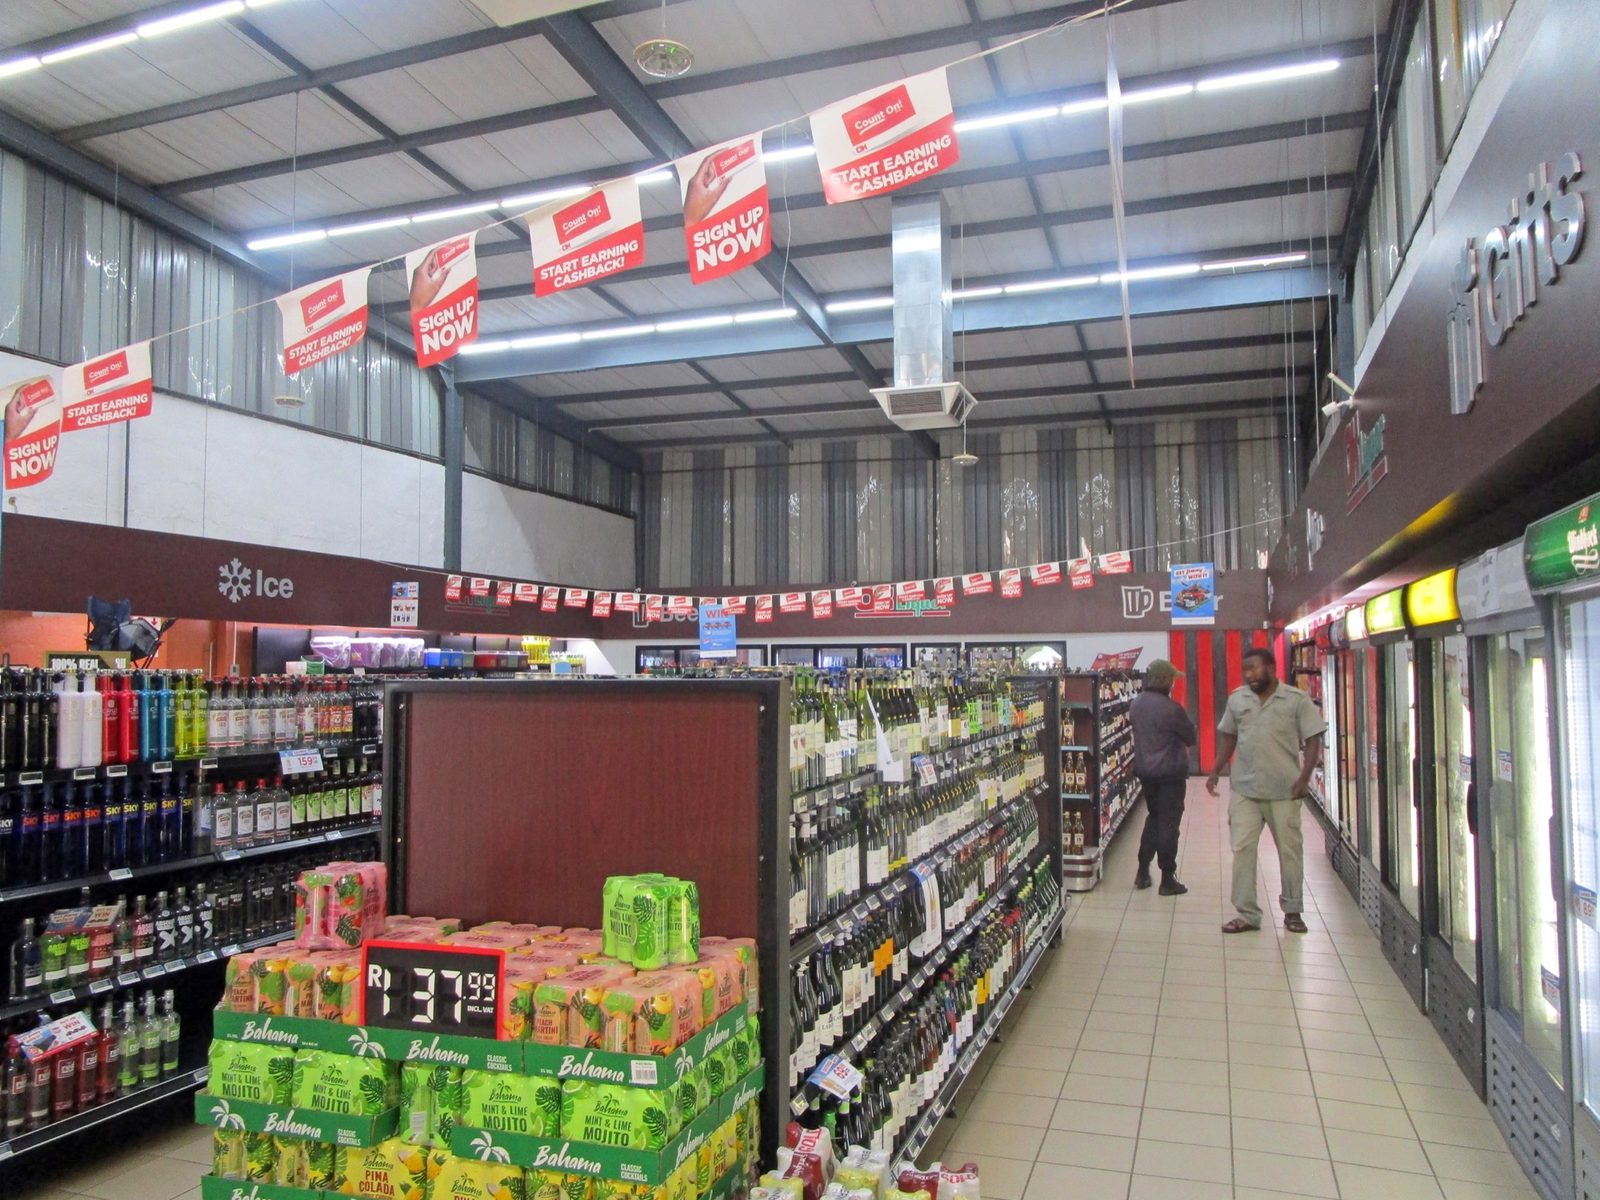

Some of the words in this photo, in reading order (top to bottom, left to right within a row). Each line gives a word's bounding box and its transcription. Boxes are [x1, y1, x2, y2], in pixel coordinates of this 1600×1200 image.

[855, 111, 885, 130] Count
[886, 100, 904, 114] On!
[830, 162, 880, 184] START
[884, 135, 952, 171] EARNING
[851, 156, 938, 194] CASHBACK!
[562, 214, 586, 230] Count
[587, 205, 602, 218] On!
[694, 220, 736, 248] SIGN
[740, 206, 763, 227] UP
[696, 221, 765, 272] NOW
[540, 260, 578, 280] START
[582, 240, 638, 267] EARNING
[554, 258, 625, 288] CASHBACK!
[308, 300, 326, 314] Count
[327, 292, 338, 302] On!
[419, 310, 454, 332] SIGN
[456, 296, 474, 317] UP
[289, 340, 318, 359] START
[320, 322, 362, 346] EARNING
[421, 312, 475, 355] NOW
[299, 338, 351, 366] CASHBACK!
[88, 367, 110, 379] Count
[110, 361, 122, 370] On!
[67, 404, 100, 418] START
[102, 394, 148, 412] EARNING
[77, 407, 136, 426] CASHBACK!
[9, 441, 40, 460] SIGN
[43, 435, 58, 450] UP
[10, 450, 56, 479] NOW
[256, 569, 294, 598] Ice
[1160, 591, 1224, 612] Br
[52, 658, 77, 670] 100%
[298, 756, 314, 766] 159
[64, 1020, 80, 1030] WIN
[242, 1017, 299, 1044] Bahama
[703, 1022, 730, 1058] Bahama
[406, 1036, 469, 1066] Bahama
[486, 1054, 507, 1064] CLASSIC
[228, 1060, 257, 1072] Bahama
[486, 1062, 512, 1072] COCKTAILS
[558, 1052, 625, 1082] Bahama
[222, 1072, 236, 1082] MINT
[238, 1074, 243, 1082] &
[245, 1074, 260, 1086] LIME
[320, 1072, 350, 1086] Bahama
[222, 1084, 260, 1100] MOJITO
[313, 1084, 326, 1094] MINT
[328, 1086, 334, 1096] &
[336, 1090, 352, 1100] LIME
[488, 1090, 522, 1103] Bahama
[733, 1082, 756, 1115] Bahama
[311, 1094, 350, 1114] MOJITO
[482, 1103, 497, 1114] MINT
[499, 1105, 506, 1114] &
[509, 1106, 528, 1116] LIME
[594, 1102, 629, 1117] Bahama
[264, 1110, 322, 1138] Bahama
[337, 1128, 356, 1137] CLASSIC
[483, 1115, 528, 1132] MOJITO
[584, 1116, 602, 1127] MINT
[604, 1118, 612, 1128] &
[614, 1120, 632, 1132] LIME
[337, 1136, 361, 1146] COCKTAILS
[583, 1126, 630, 1146] MOJITO
[533, 1143, 602, 1174] Bahama
[675, 1128, 704, 1170] Bahama
[362, 1156, 394, 1170] Bahama
[620, 1163, 642, 1172] CLASSIC
[365, 1170, 388, 1182] PINA
[620, 1170, 648, 1182] COCKTAILS
[359, 1180, 394, 1197] COLADA
[450, 1181, 482, 1197] Bahama
